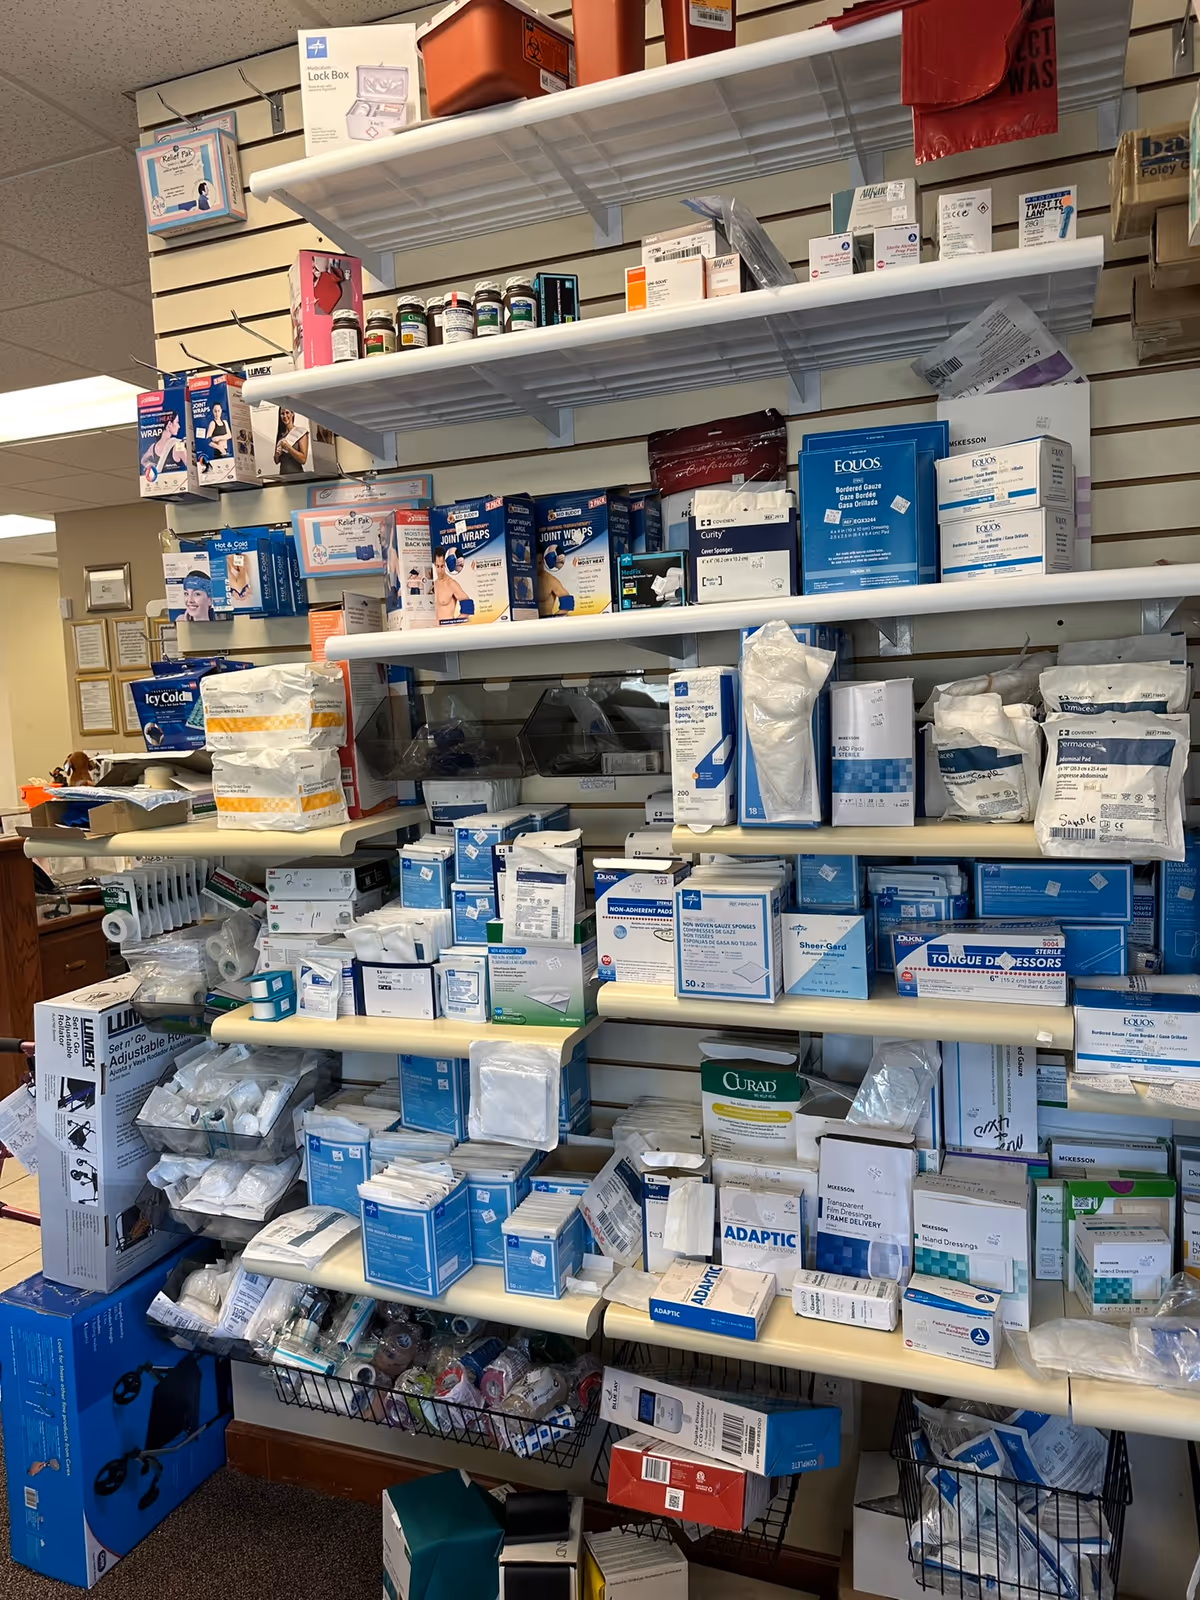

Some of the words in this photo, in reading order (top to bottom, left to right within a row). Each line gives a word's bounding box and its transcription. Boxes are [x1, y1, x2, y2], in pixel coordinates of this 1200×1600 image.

[308, 70, 327, 81] Lock
[331, 69, 349, 80] Box
[161, 150, 178, 163] Relief
[180, 149, 193, 159] Pak
[1141, 163, 1178, 178] Foley
[1180, 162, 1189, 173] C
[1026, 200, 1052, 211] TWIST
[247, 365, 272, 378] LUMEX
[192, 406, 210, 415] WRAPS
[140, 428, 163, 439] WRAP
[686, 457, 749, 477] Comfortable
[834, 456, 884, 474] EQUOS
[971, 455, 997, 468] EQUOS
[836, 484, 862, 494] Bordered
[863, 482, 882, 491] Gauze
[839, 493, 855, 502] Gaze
[838, 501, 853, 510] Gasa
[854, 499, 878, 509] Orillada
[337, 517, 354, 529] Relief
[355, 516, 370, 526] Pak
[976, 523, 1001, 533] EQUOS
[440, 532, 460, 546] JOINT
[461, 528, 491, 543] WRAPS
[539, 530, 563, 544] JOINT
[700, 530, 723, 541] Curity
[214, 541, 226, 550] Hot
[234, 540, 248, 549] Cold
[404, 541, 419, 549] BACK
[461, 541, 477, 550] LARGE
[700, 547, 713, 556] Cover
[714, 546, 734, 556] Sponges
[490, 560, 502, 568] HEAT
[145, 692, 161, 706] Icy
[161, 691, 185, 705] Cold
[674, 704, 691, 712] Gauze
[838, 745, 851, 753] ABD
[851, 745, 865, 753] Pads
[1081, 755, 1091, 763] Pad
[1079, 771, 1108, 779] abdominale
[748, 807, 758, 815] 18
[1058, 812, 1096, 828] Sample
[655, 878, 668, 886] 123
[609, 905, 657, 915] NON-ADHERENT
[657, 907, 673, 915] PADS
[799, 941, 848, 952] Sheer-Gard
[1034, 948, 1062, 956] STERILE
[931, 954, 982, 966] TONGUE
[985, 955, 1062, 968] DEESSORS
[685, 979, 696, 988] 50
[700, 981, 706, 989] 2
[989, 975, 999, 983] 6"
[1014, 977, 1028, 985] cm)
[1046, 978, 1064, 986] Sized
[72, 1016, 80, 1031] Set
[1123, 1016, 1155, 1028] EQUOS
[57, 1014, 65, 1047] Rollator
[65, 1015, 74, 1059] Adjustable
[73, 1042, 80, 1054] Go
[83, 1018, 96, 1068] LUMEX
[108, 1040, 124, 1055] Set
[134, 1032, 147, 1045] Go
[109, 1037, 166, 1068] Adjustable
[109, 1064, 128, 1077] Ajusta
[127, 1062, 132, 1070] y
[132, 1056, 146, 1068] Vaya
[146, 1046, 169, 1063] Rodador
[169, 1037, 192, 1052] Ajustable
[1017, 1056, 1025, 1077] Gauze
[722, 1071, 777, 1093] CURAD
[827, 1197, 865, 1211] Transparent
[826, 1205, 840, 1215] Film
[840, 1207, 873, 1221] Dressings
[826, 1213, 849, 1224] FRAME
[849, 1217, 882, 1230] DELIVERY
[723, 1224, 798, 1248] ADAPTIC
[723, 1239, 767, 1252] NON-ADHERING
[767, 1243, 797, 1255] DRESSING
[921, 1235, 943, 1246] Island
[943, 1239, 979, 1251] Dressings
[690, 1265, 724, 1306] ADAPTIC
[654, 1307, 681, 1318] ADAPTIC
[694, 1400, 702, 1427] Display
[61, 1414, 69, 1442] products
[791, 1459, 818, 1471] COMPLETE
